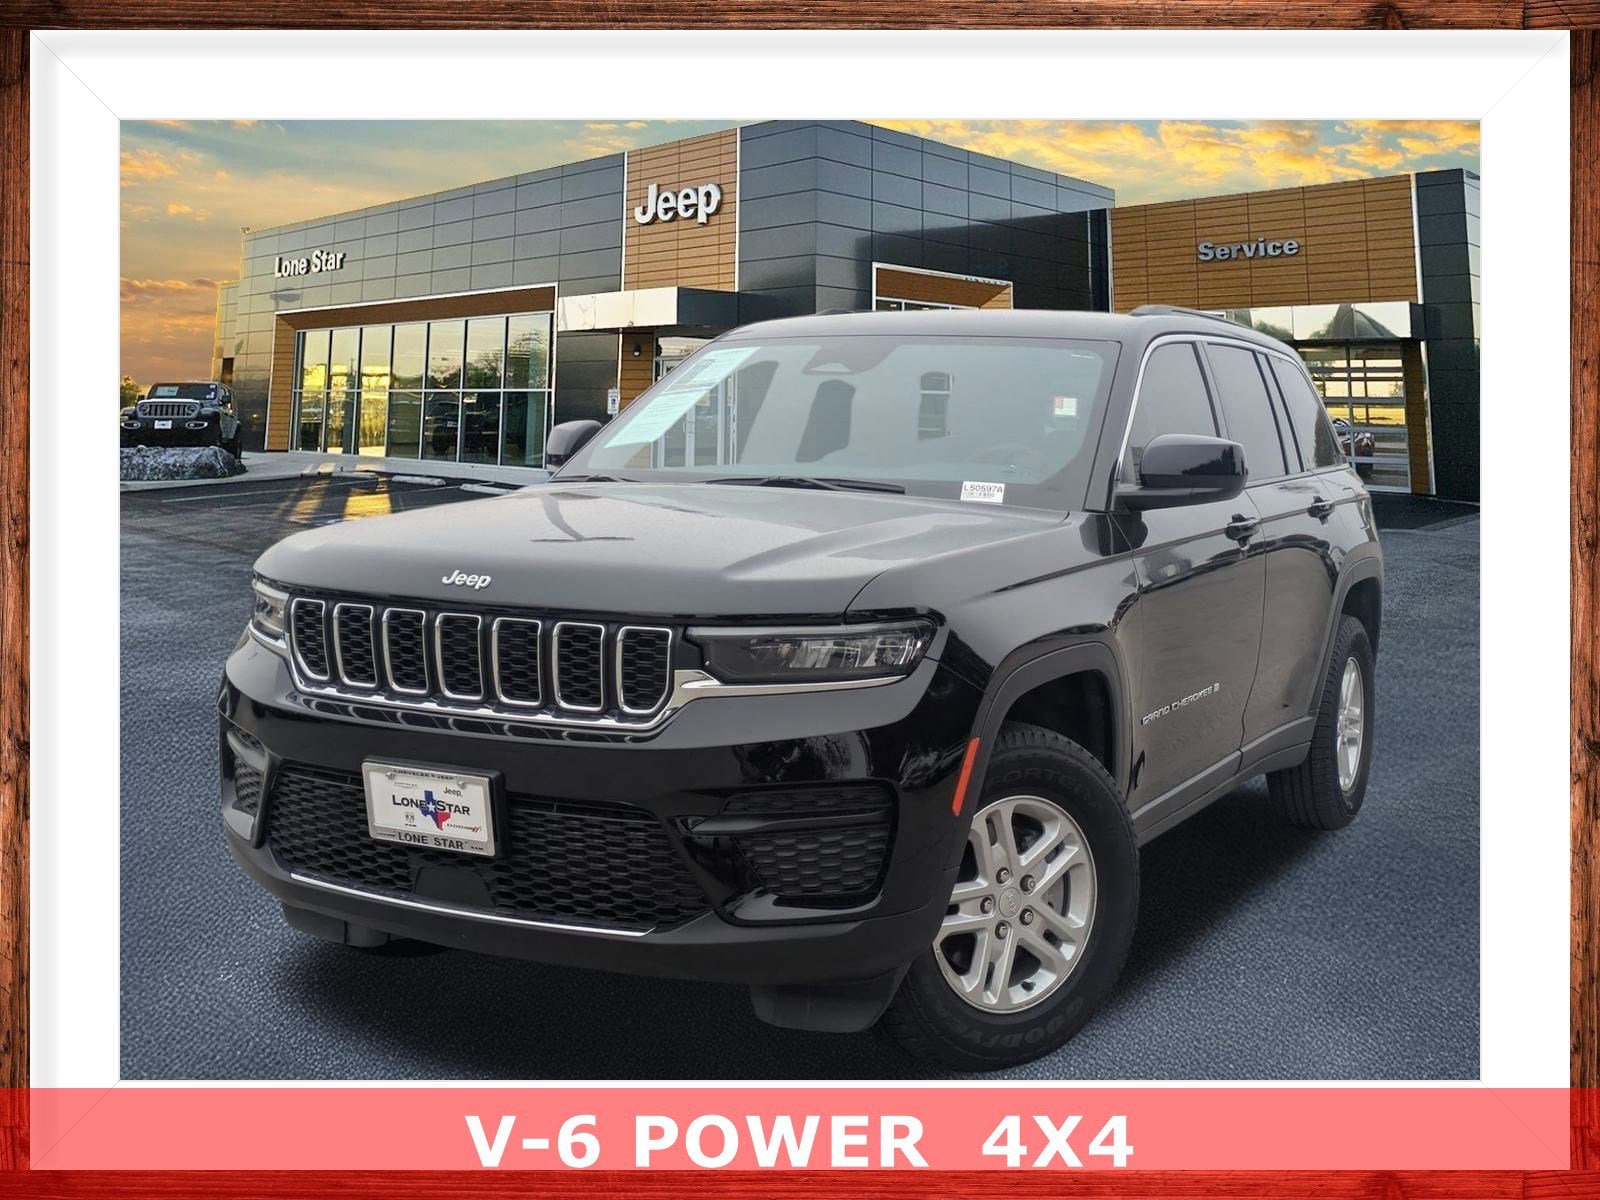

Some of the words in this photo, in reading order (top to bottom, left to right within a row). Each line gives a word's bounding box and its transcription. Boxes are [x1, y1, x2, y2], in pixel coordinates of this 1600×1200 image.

[634, 183, 722, 224] Jeep
[1198, 237, 1299, 261] Service
[274, 257, 311, 278] Lone
[311, 249, 346, 273] Star
[441, 569, 491, 590] Jeep
[1142, 705, 1170, 726] GRAND
[1171, 686, 1213, 711] CHEROKEE
[443, 786, 462, 797] Jeep
[392, 794, 427, 809] LONE
[437, 800, 471, 815] STAR
[398, 832, 429, 845] LONE
[434, 837, 465, 849] STAR
